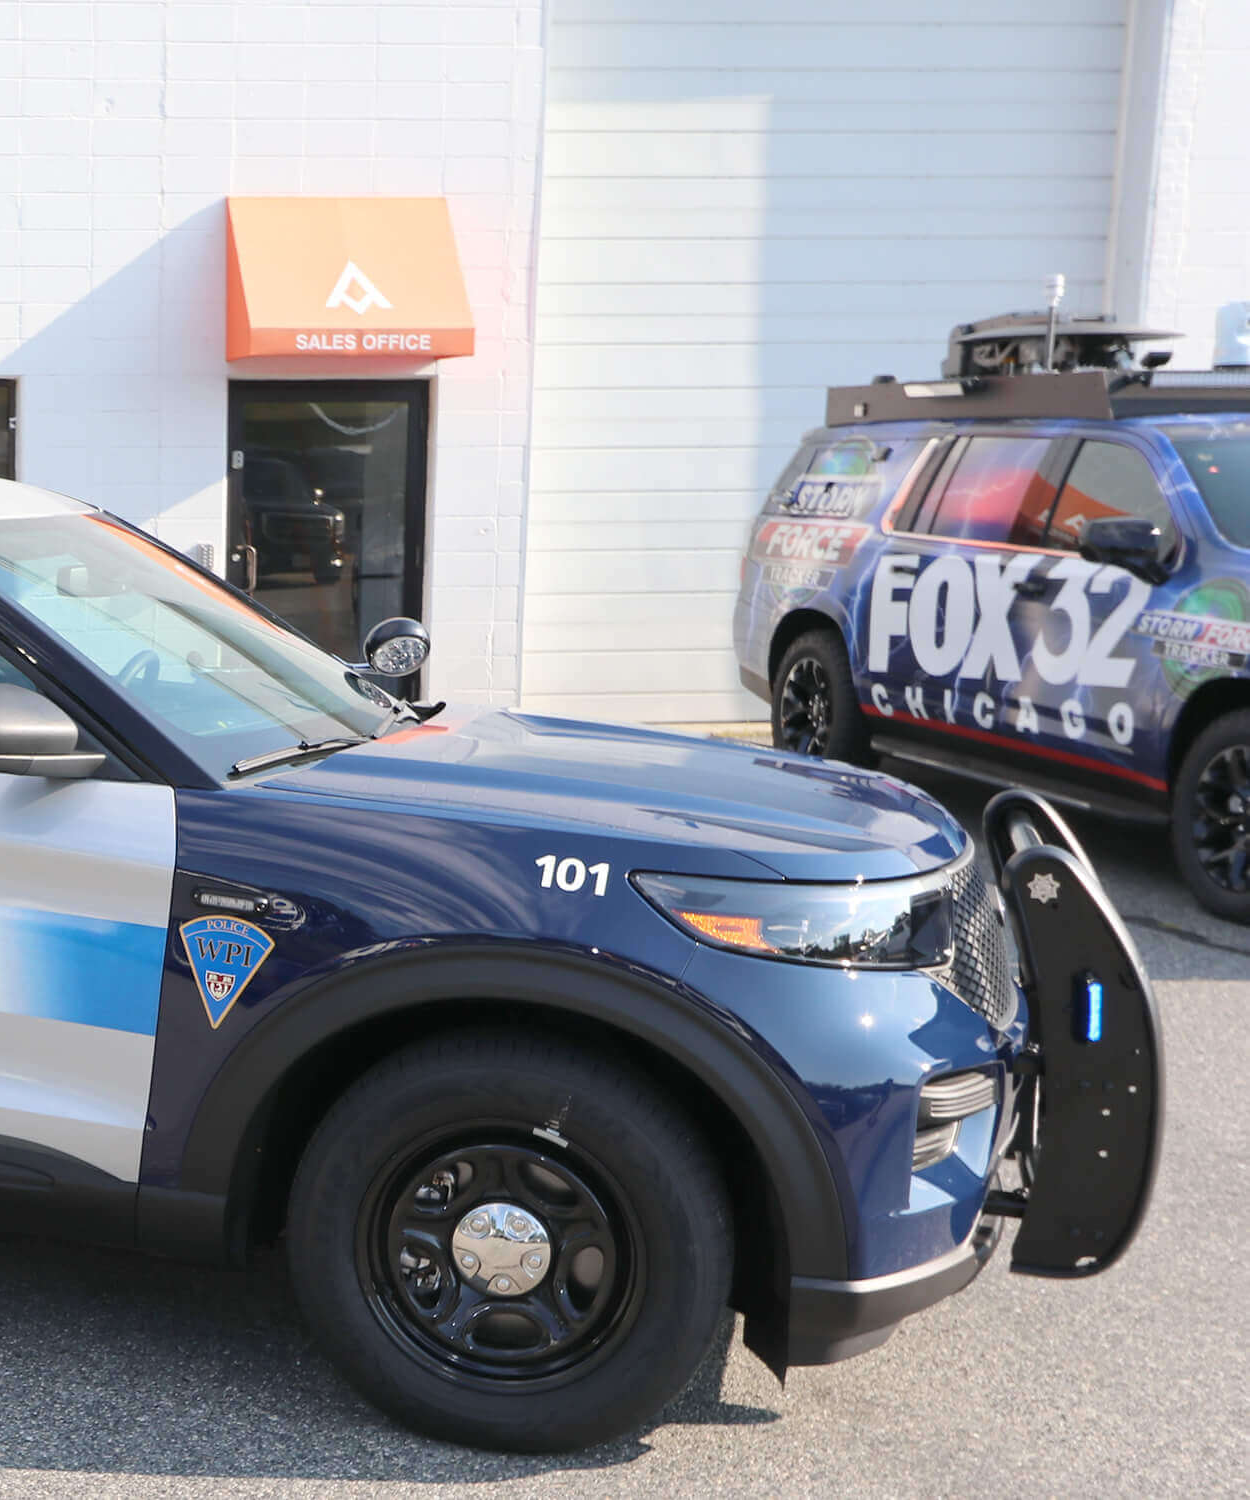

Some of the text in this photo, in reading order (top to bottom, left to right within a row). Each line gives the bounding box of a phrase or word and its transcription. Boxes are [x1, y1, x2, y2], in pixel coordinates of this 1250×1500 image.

[295, 334, 431, 351] SALES OFFICE
[765, 524, 854, 561] FORCE
[868, 554, 1152, 688] FOX 32
[1138, 615, 1199, 640] STORM
[1164, 641, 1230, 666] TRACKER
[871, 682, 1134, 746] CHICAGO
[535, 855, 610, 897] 101
[206, 919, 250, 935] POLICE
[195, 936, 254, 968] WPI
